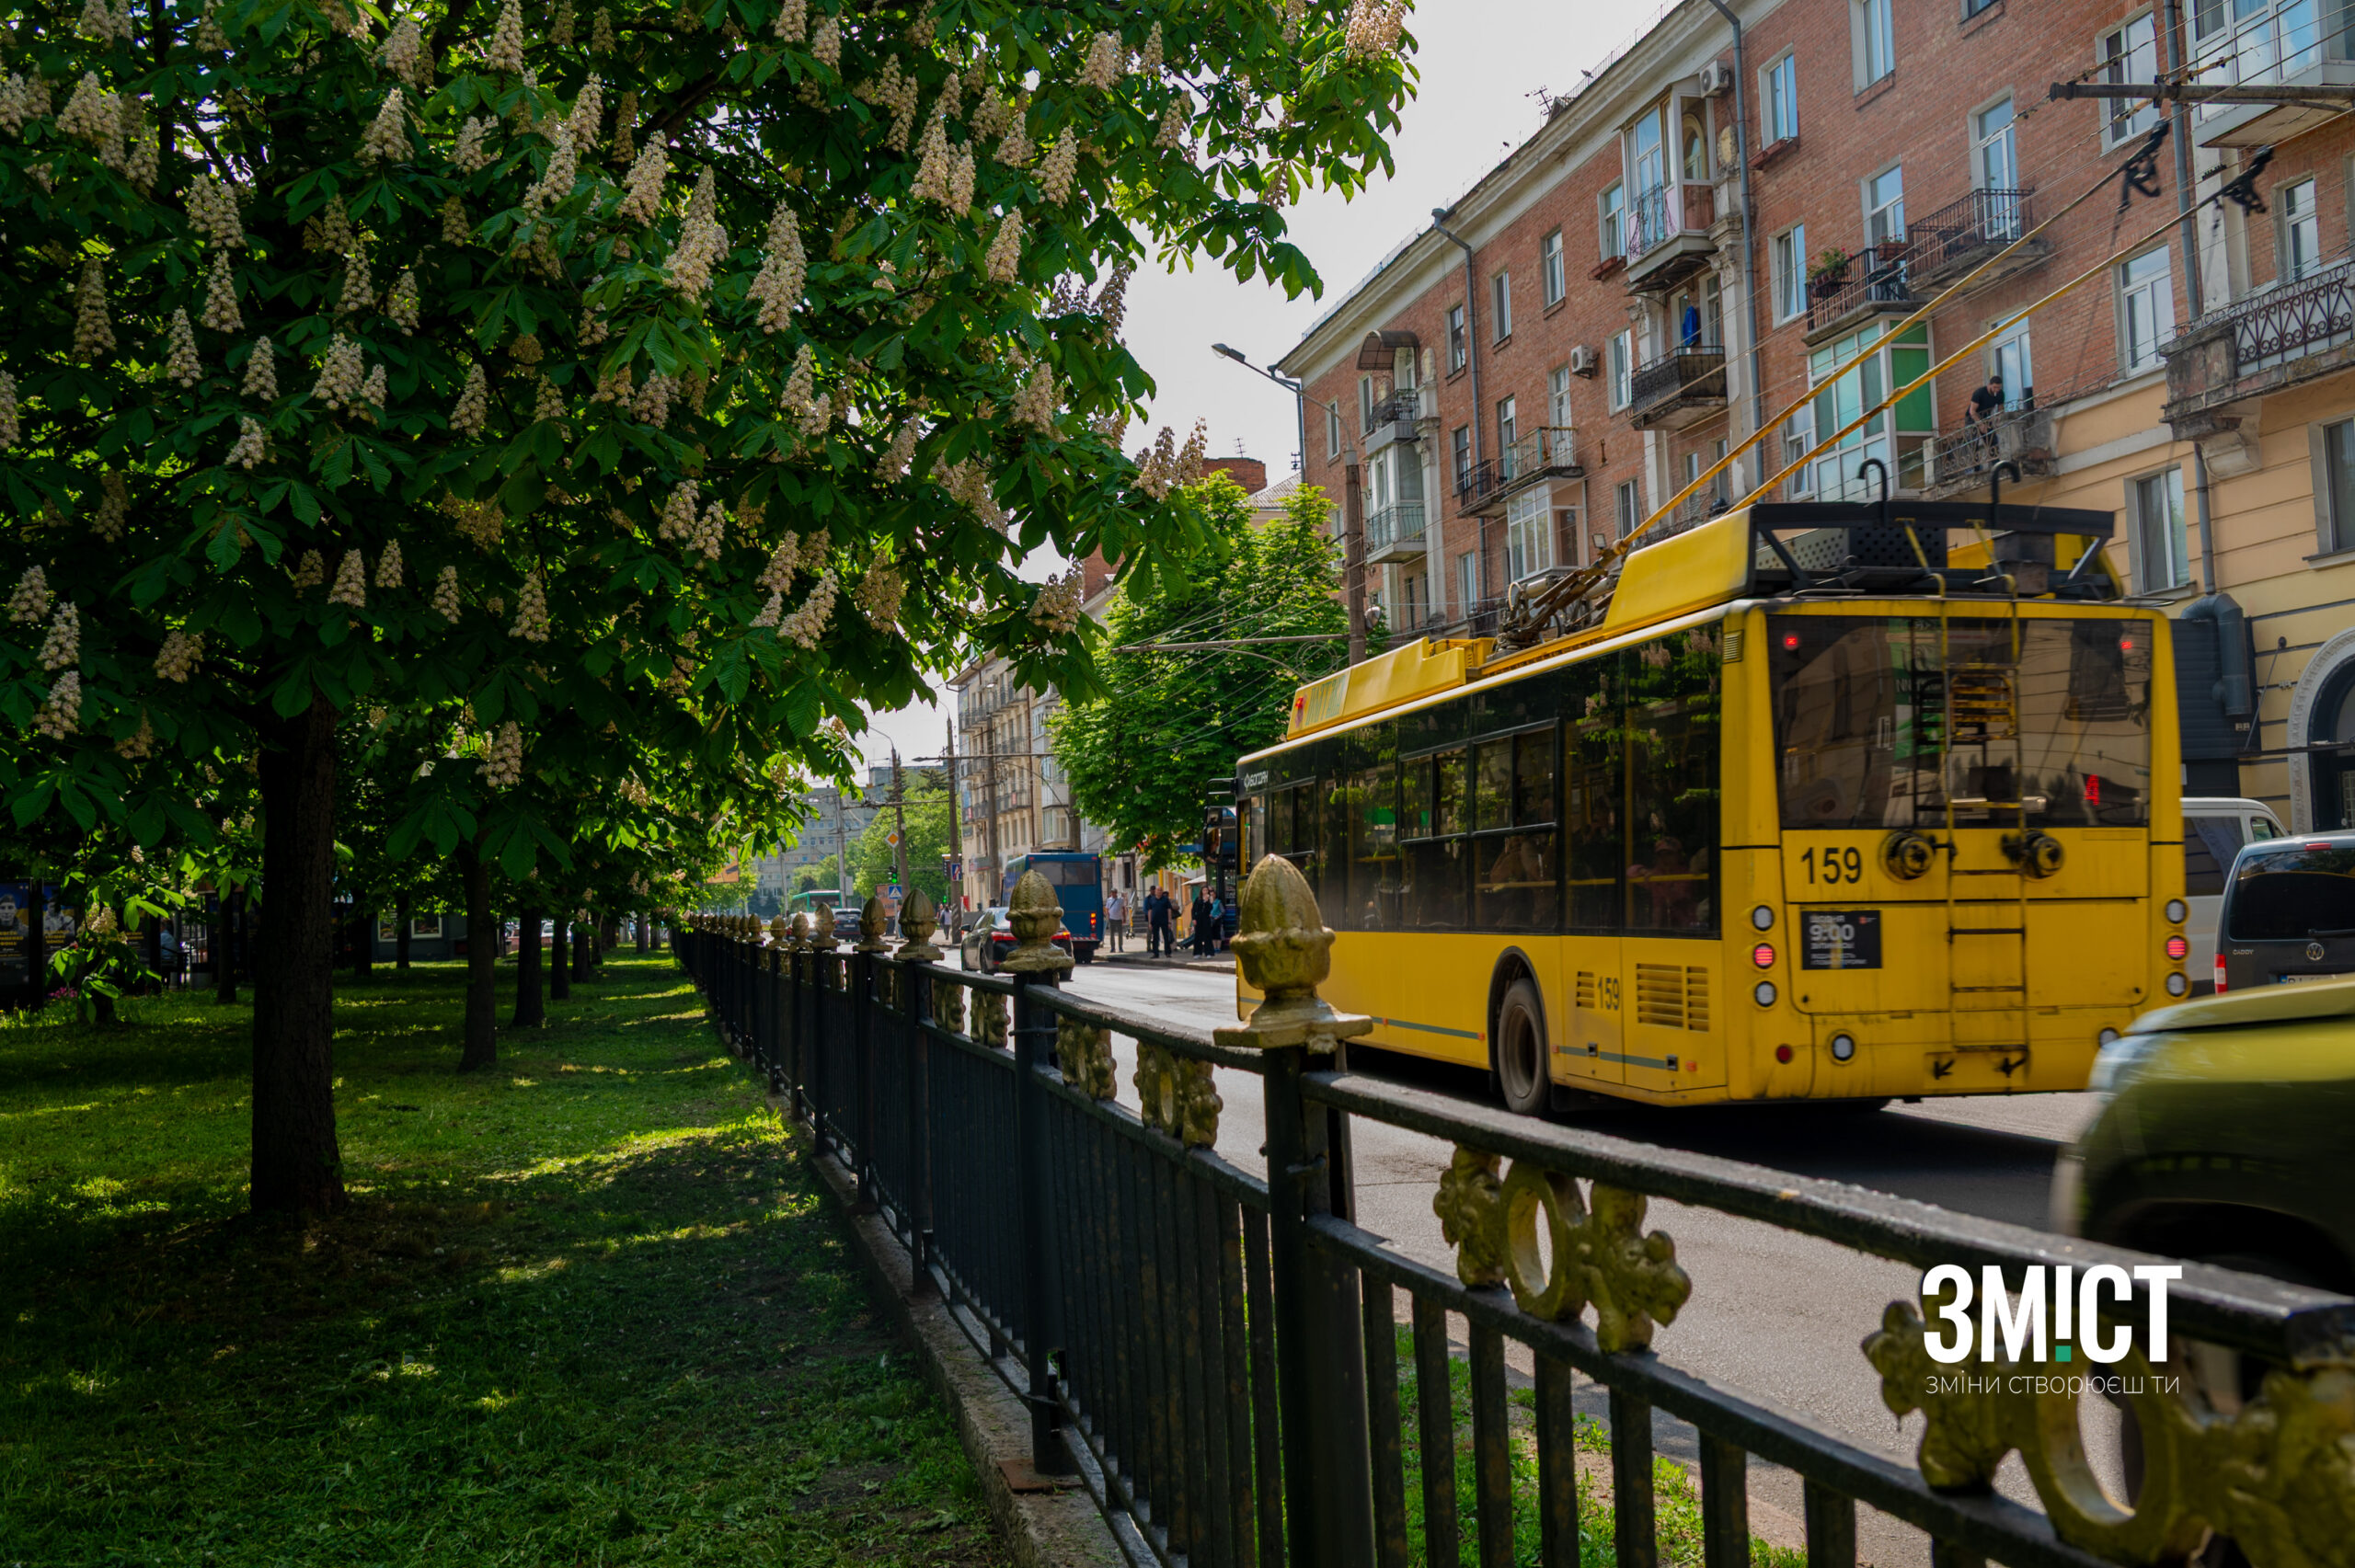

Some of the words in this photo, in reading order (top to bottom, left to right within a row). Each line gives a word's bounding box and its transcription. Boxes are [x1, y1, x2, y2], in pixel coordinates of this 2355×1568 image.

[1800, 846, 1862, 884] 159
[1809, 923, 1855, 941] 9:00
[1598, 976, 1619, 1010] 159
